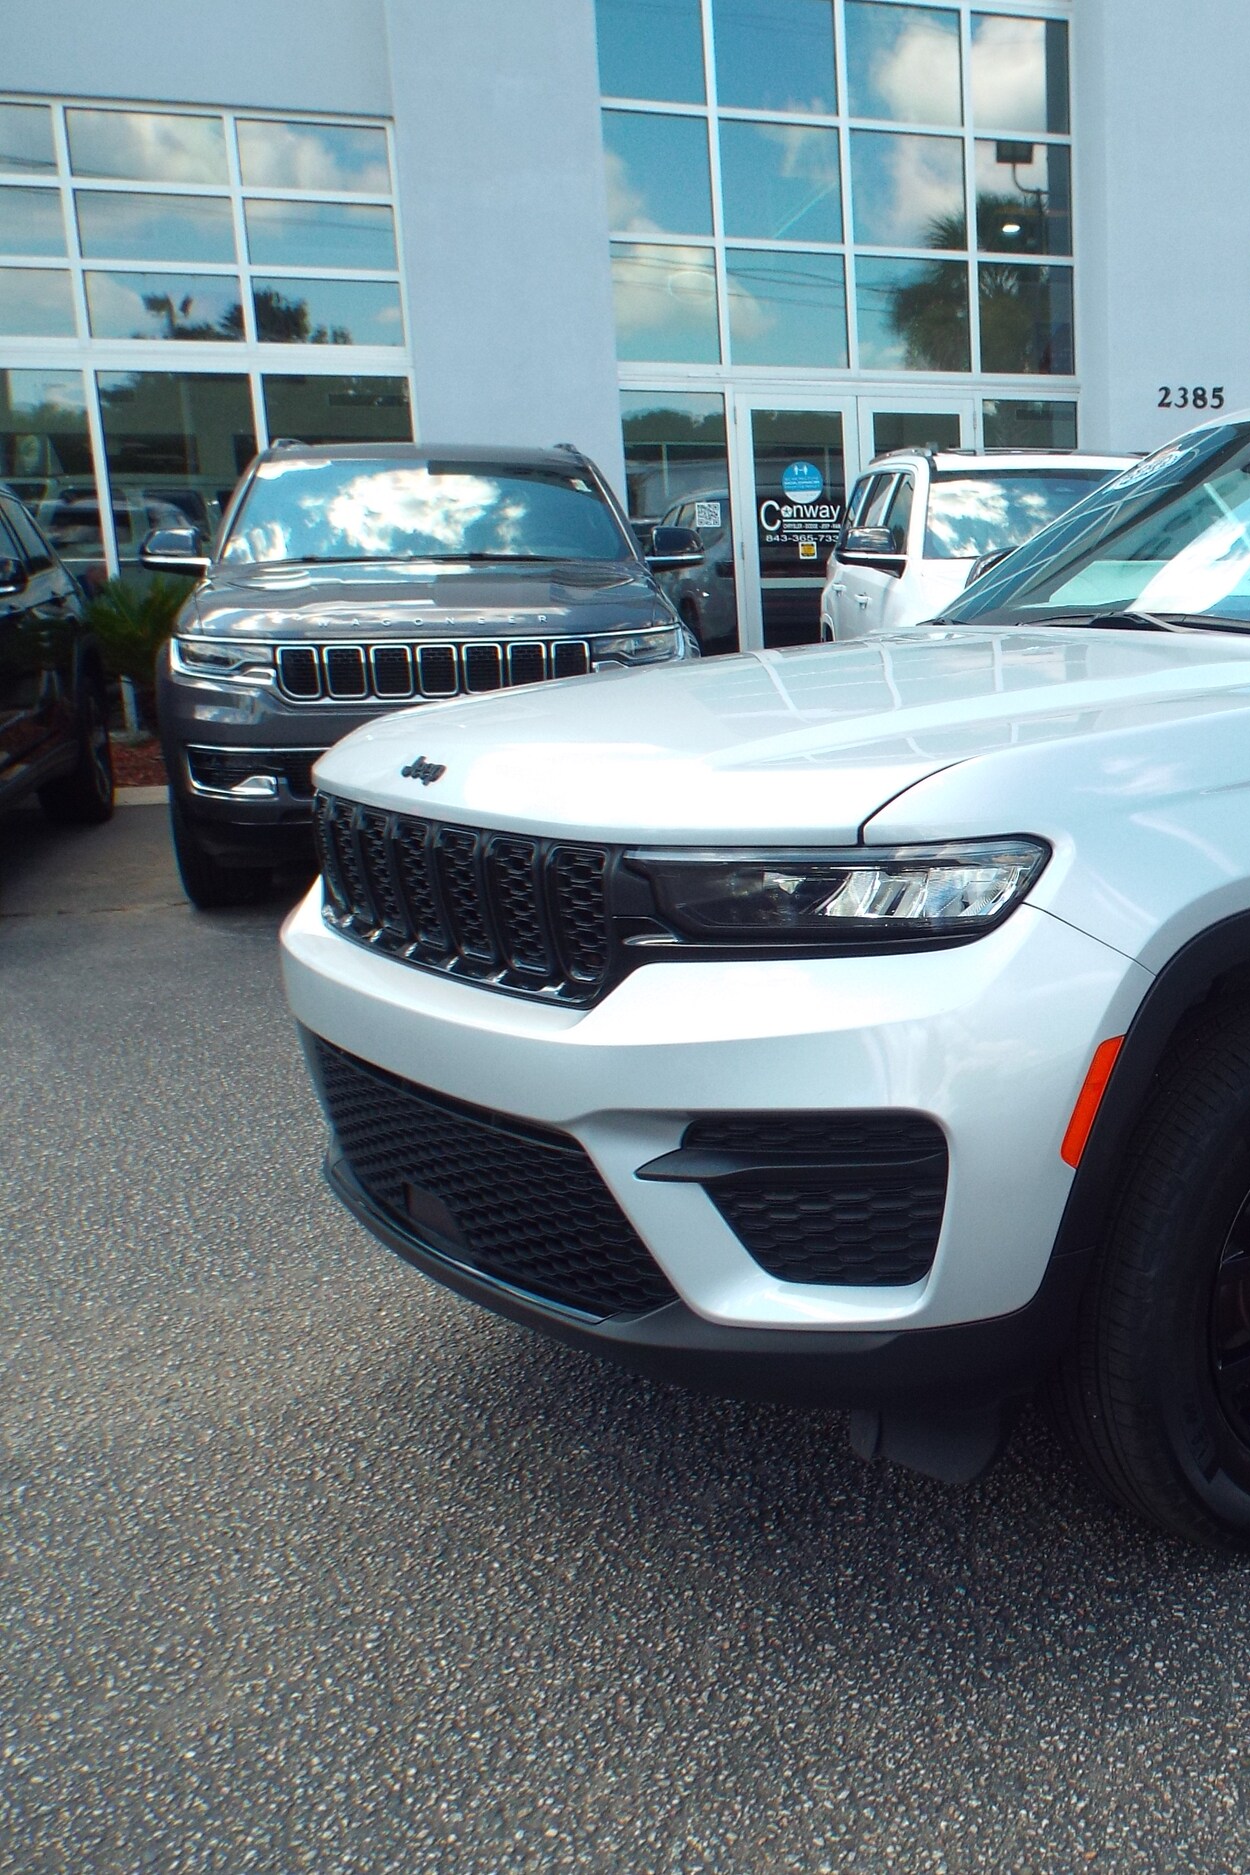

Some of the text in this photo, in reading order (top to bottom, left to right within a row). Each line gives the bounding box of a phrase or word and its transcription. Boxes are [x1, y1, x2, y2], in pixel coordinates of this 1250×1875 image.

[1157, 386, 1225, 409] 2385
[760, 500, 841, 531] Conway
[765, 534, 840, 542] 843-365-733
[318, 615, 548, 628] WAGONEER
[401, 755, 447, 787] Jeep
